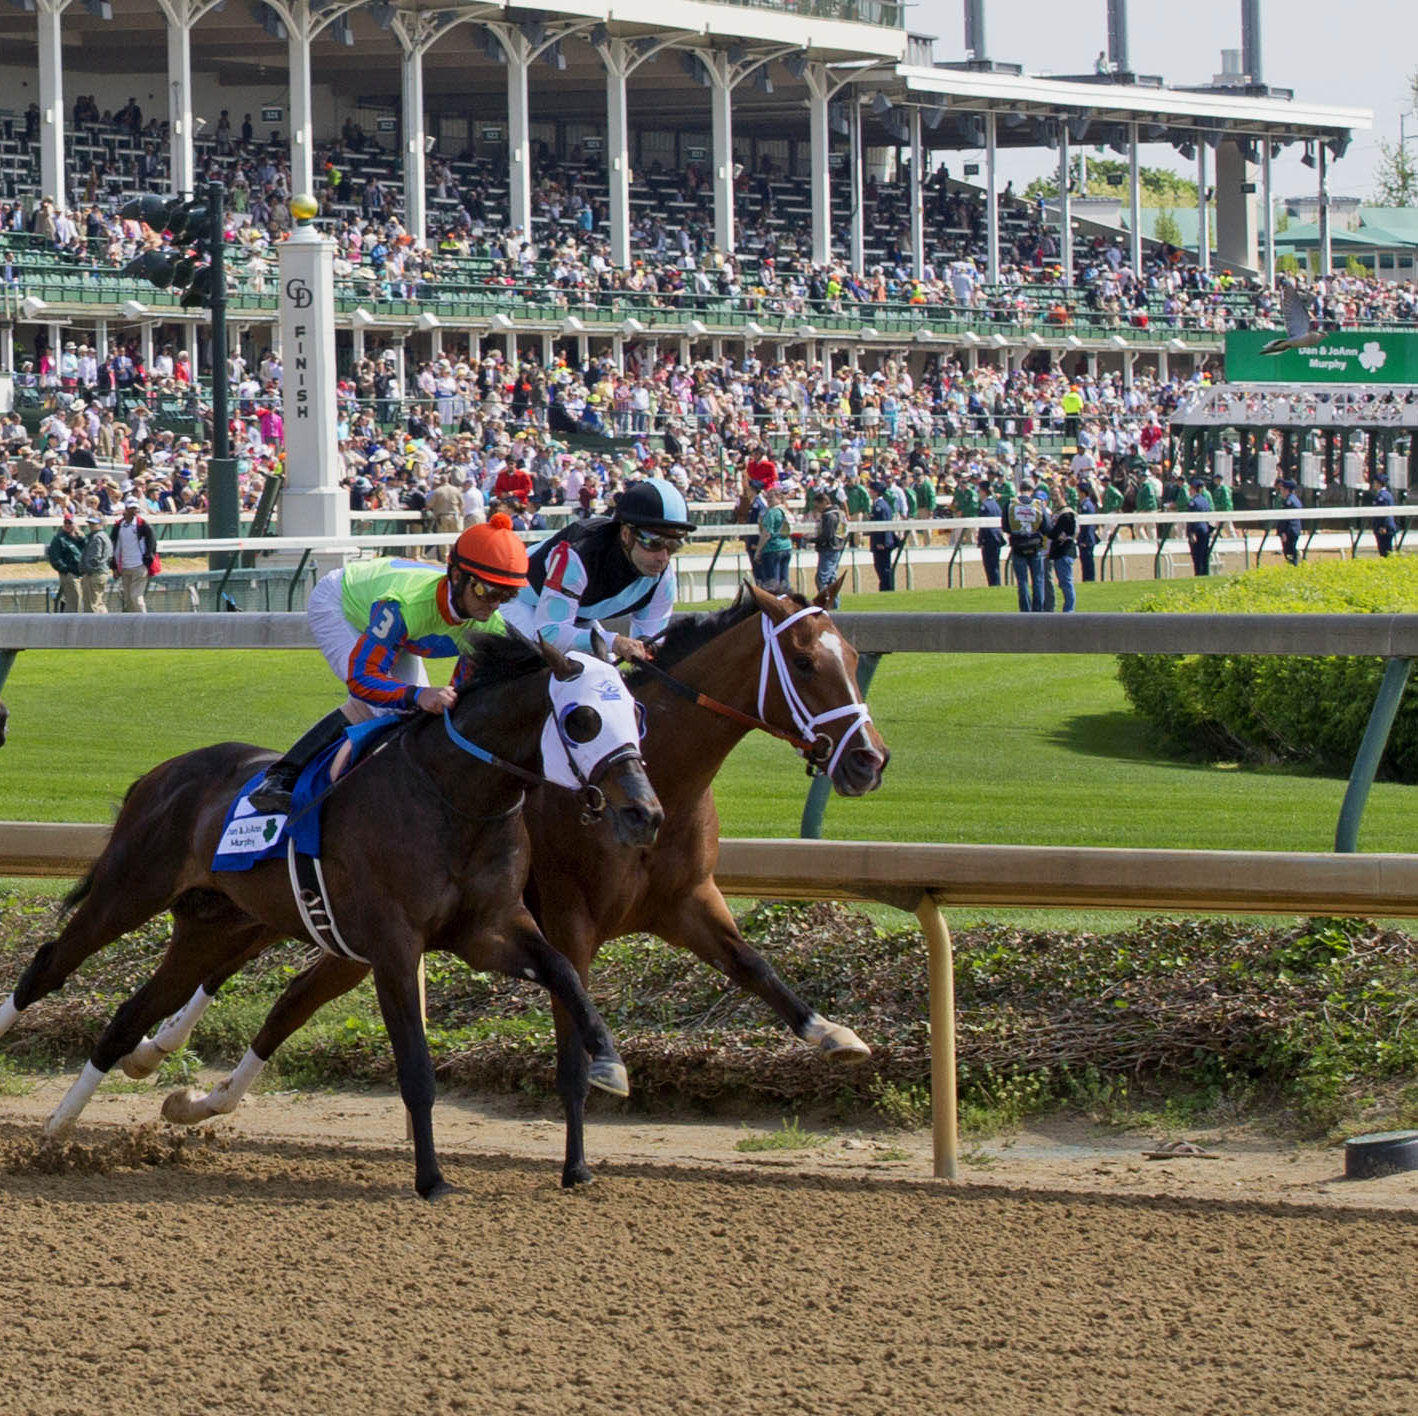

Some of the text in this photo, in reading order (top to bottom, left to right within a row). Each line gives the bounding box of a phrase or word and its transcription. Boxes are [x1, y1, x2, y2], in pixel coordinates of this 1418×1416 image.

[1319, 345, 1327, 355] &
[1328, 347, 1359, 357] JoAnn
[294, 325, 309, 419] FINISH
[1309, 358, 1347, 371] Murphy
[371, 607, 395, 640] 3
